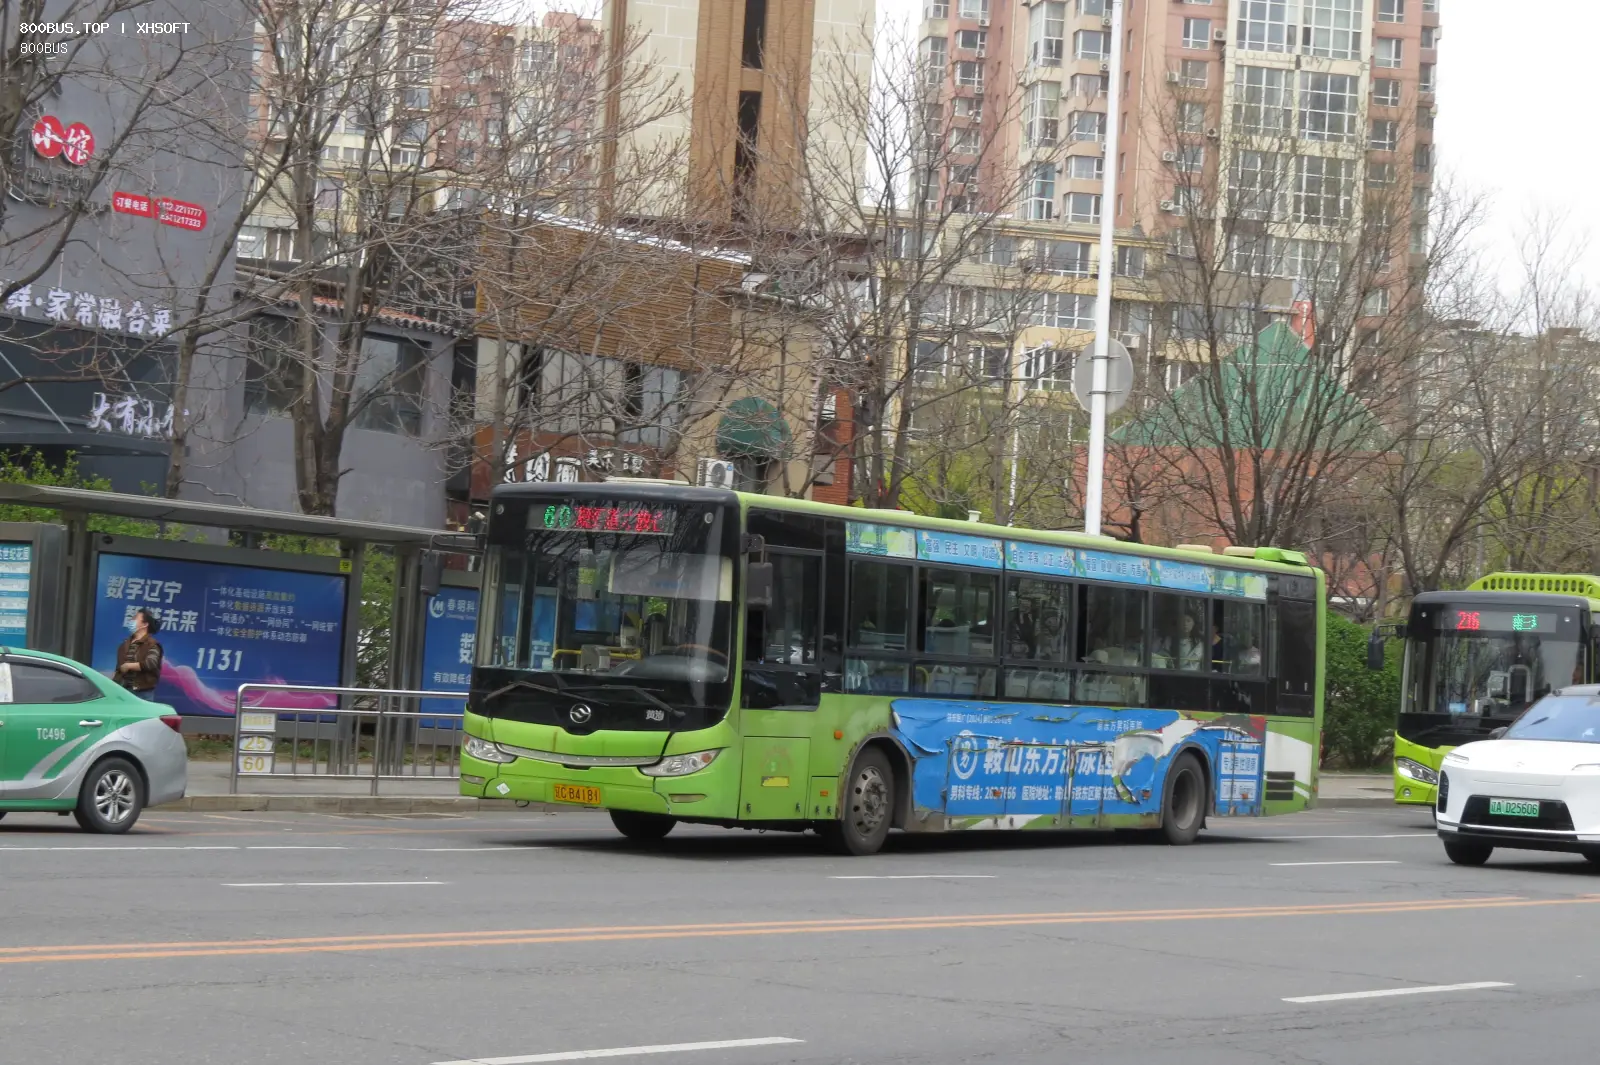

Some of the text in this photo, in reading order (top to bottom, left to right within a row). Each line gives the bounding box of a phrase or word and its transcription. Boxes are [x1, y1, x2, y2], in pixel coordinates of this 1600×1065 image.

[105, 576, 182, 603] 数字辽宁
[196, 647, 243, 672] 1131
[36, 727, 66, 741] TC496
[243, 756, 265, 771] 60
